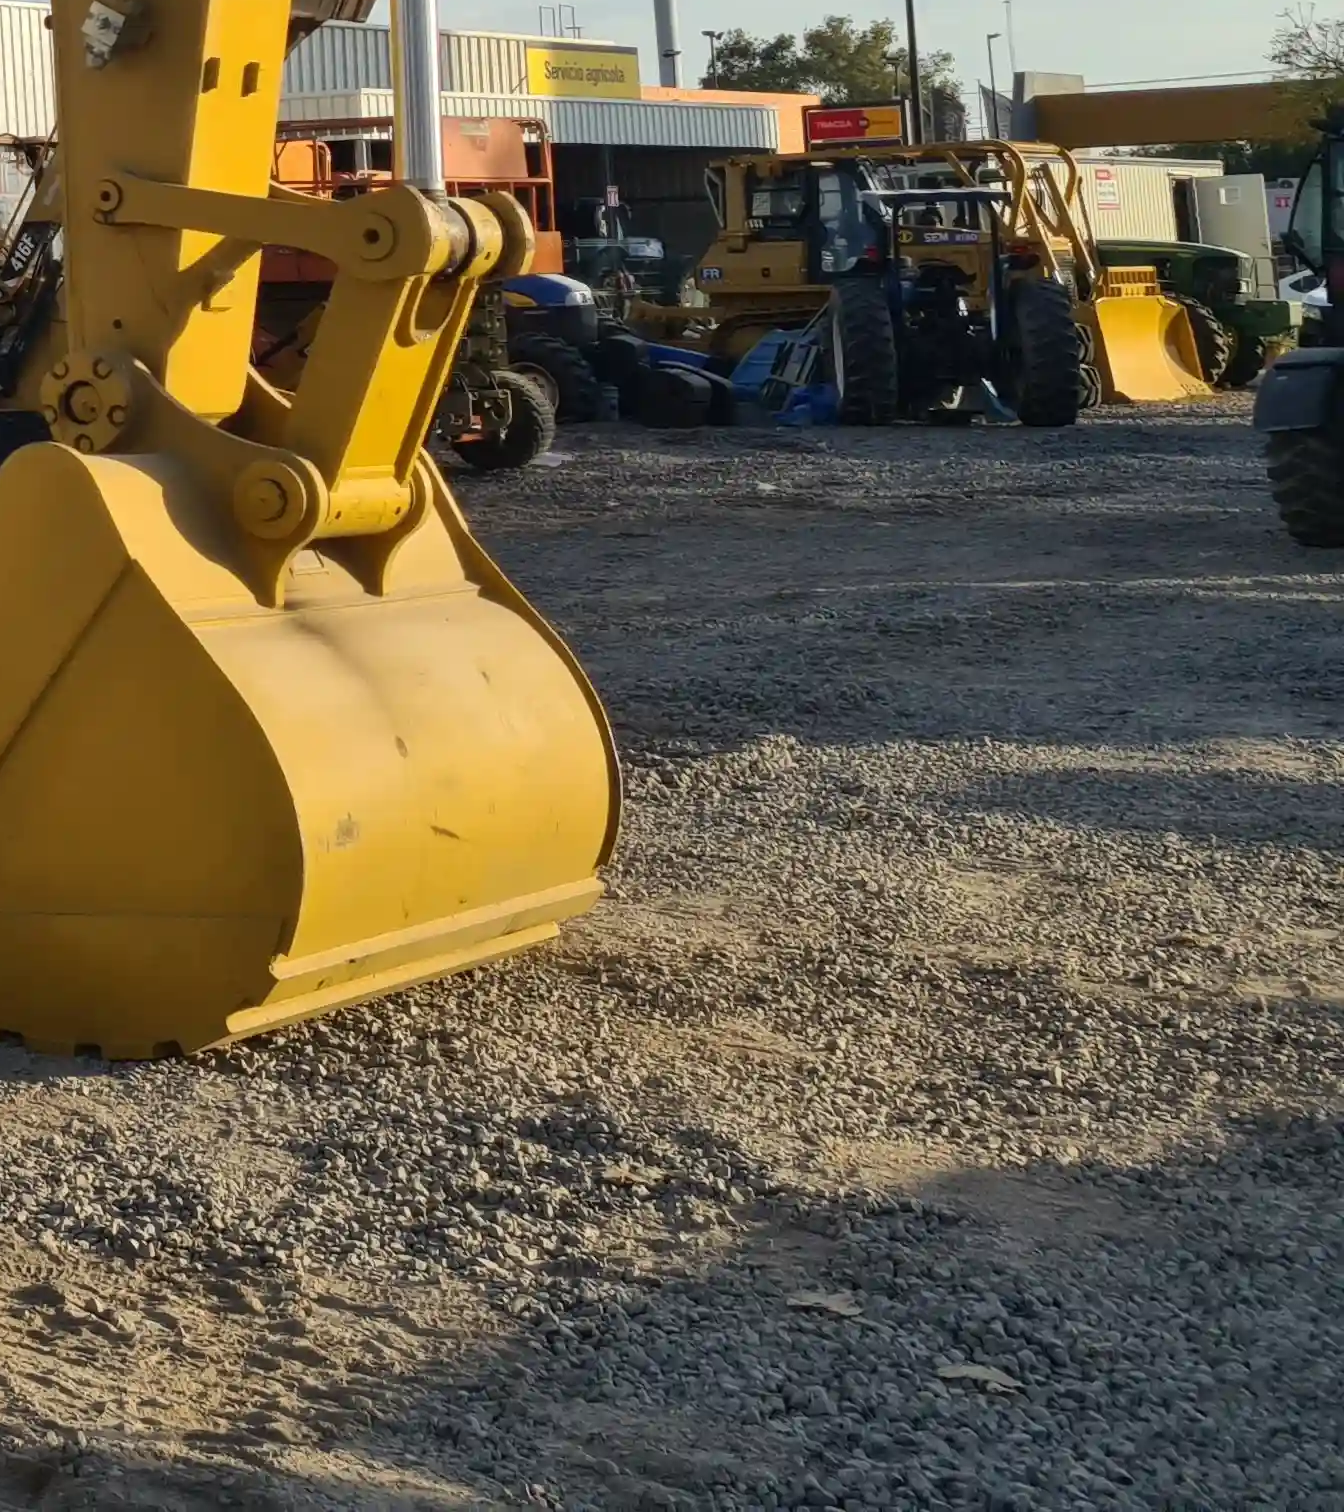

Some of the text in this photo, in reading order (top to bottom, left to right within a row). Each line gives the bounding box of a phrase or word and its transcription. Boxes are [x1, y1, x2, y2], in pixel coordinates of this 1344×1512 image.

[544, 60, 584, 81] Servicio
[924, 233, 949, 243] SEM
[10, 232, 35, 271] 416F
